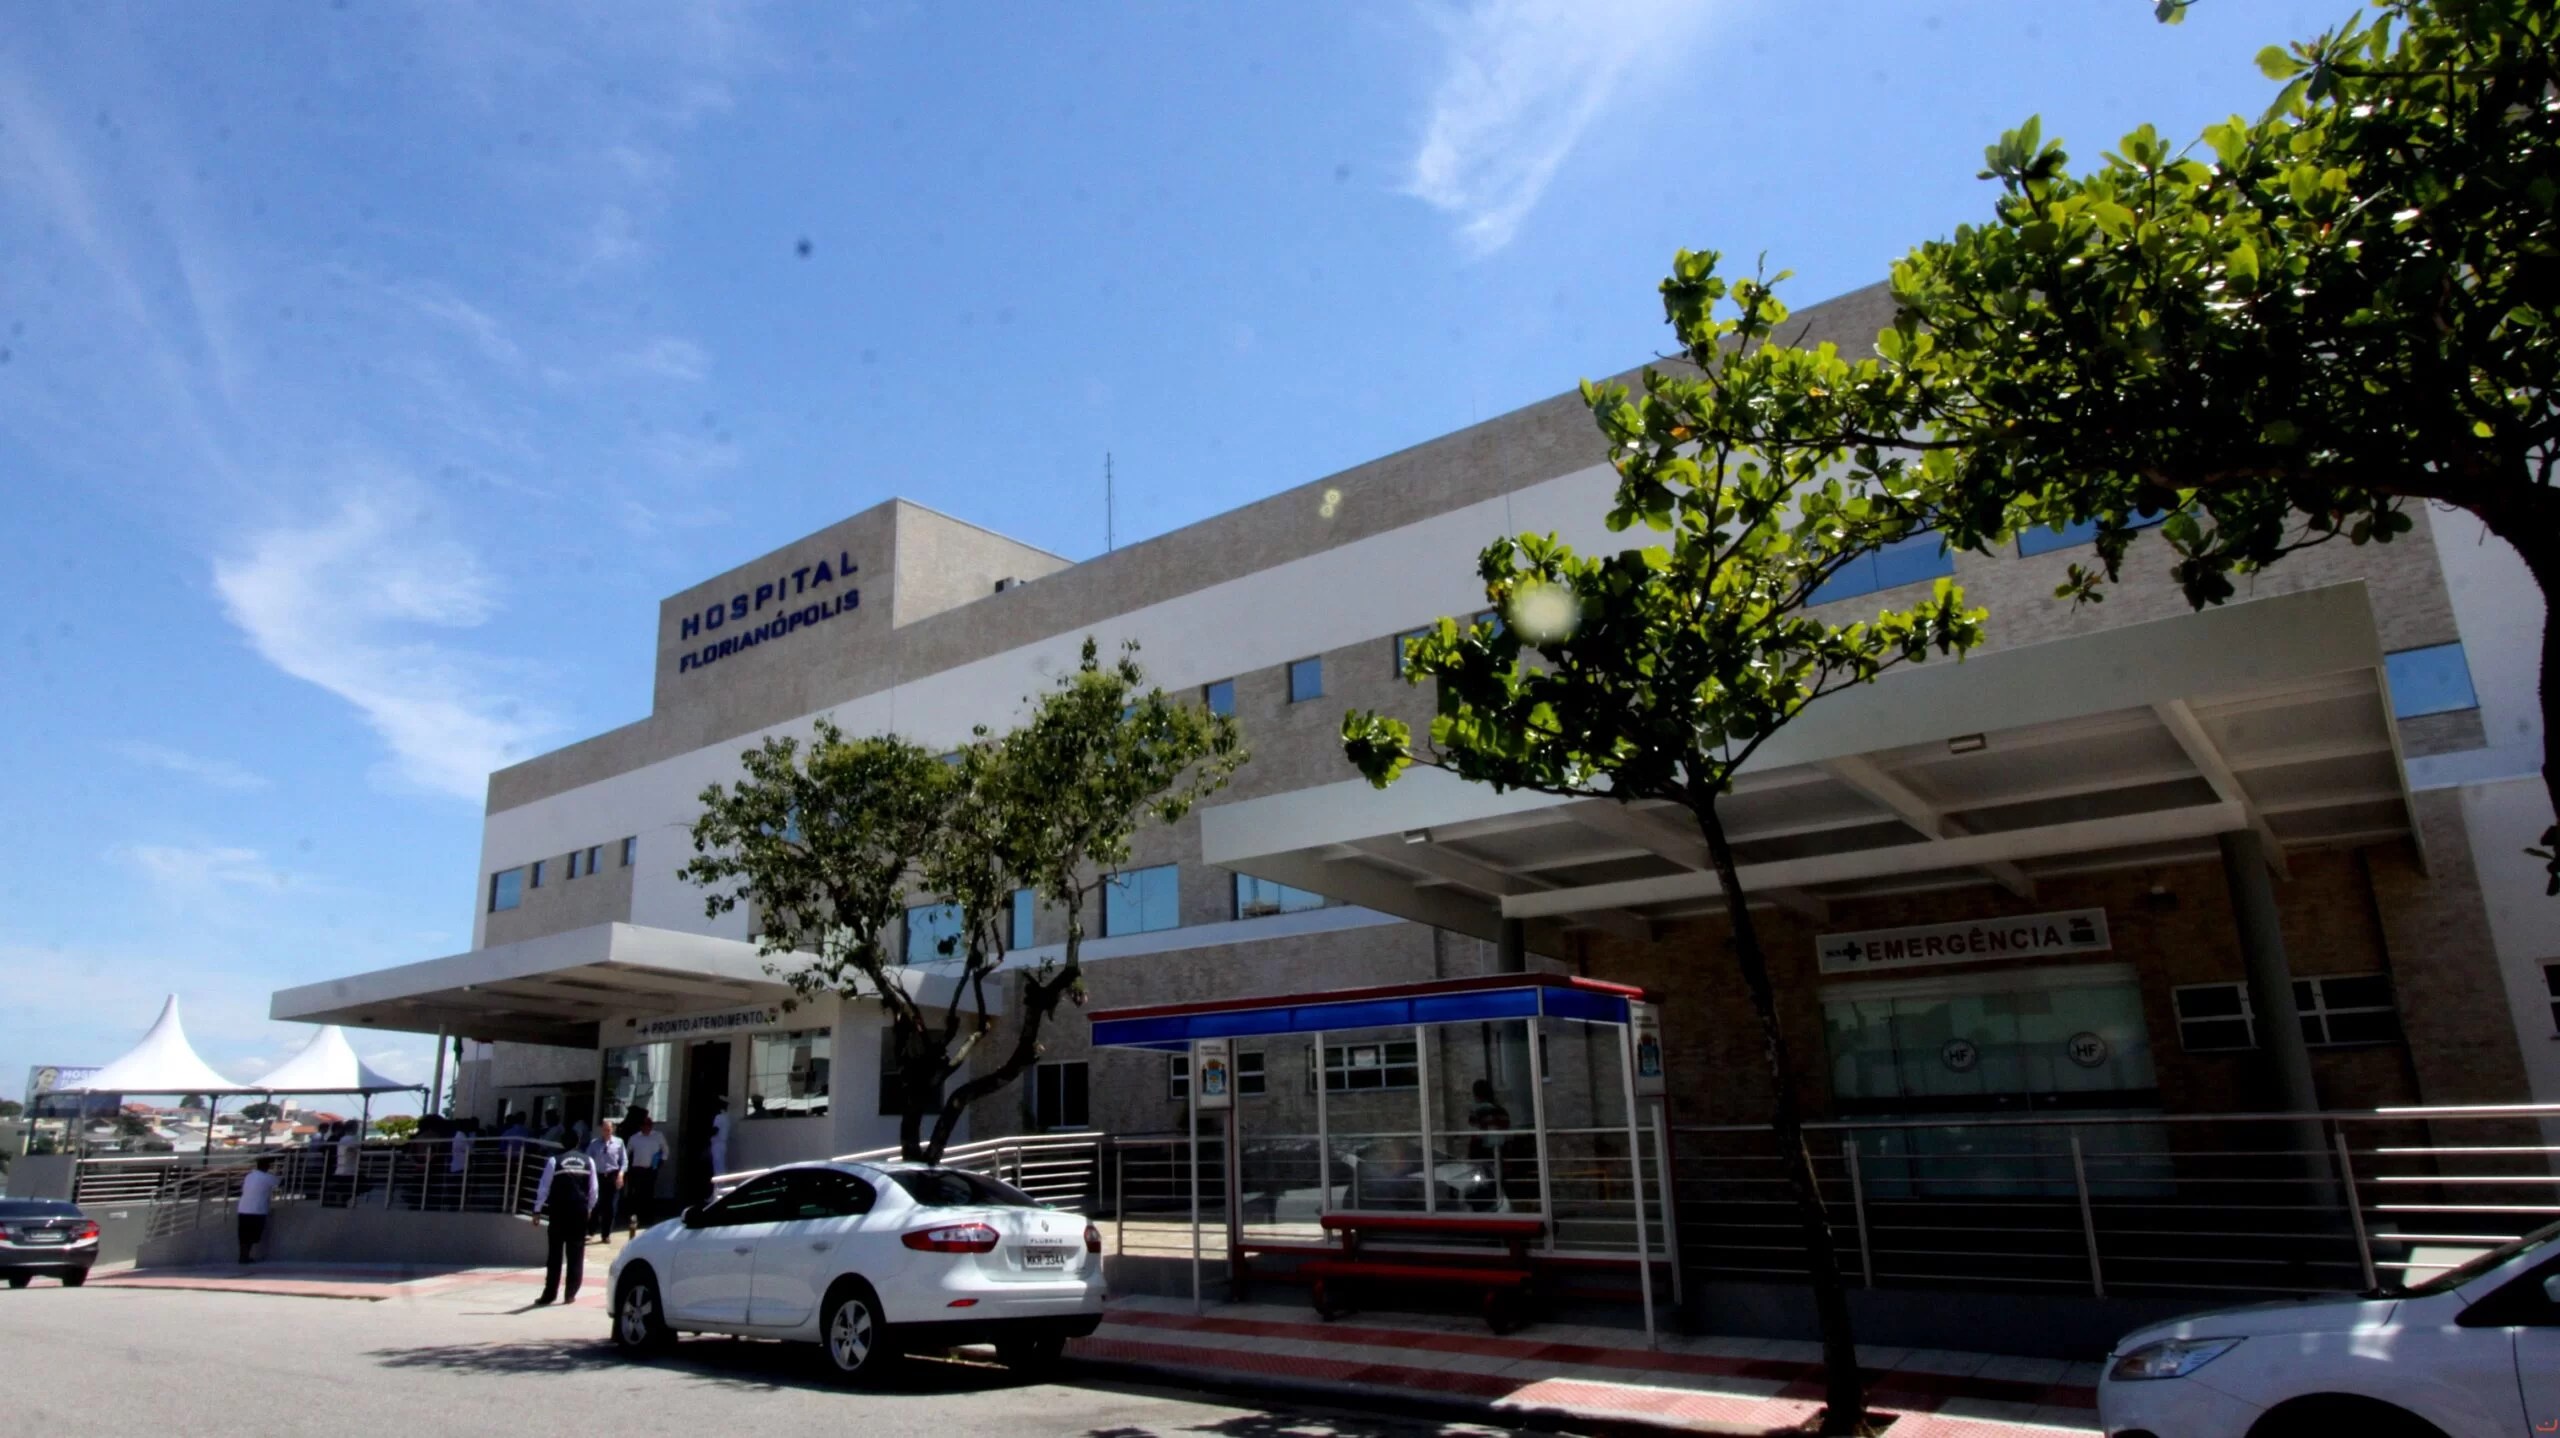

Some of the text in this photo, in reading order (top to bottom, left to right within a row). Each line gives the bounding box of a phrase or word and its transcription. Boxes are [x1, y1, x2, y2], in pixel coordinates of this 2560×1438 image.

[681, 551, 858, 641] HOSPITAL
[679, 589, 860, 674] FLORIANÓPOLIS
[1865, 925, 2063, 961] EMERGÊNCIA
[651, 1010, 763, 1034] PRONTO ATENDIMENTO
[1948, 1049, 1969, 1062] HF
[2075, 1043, 2097, 1057] HF
